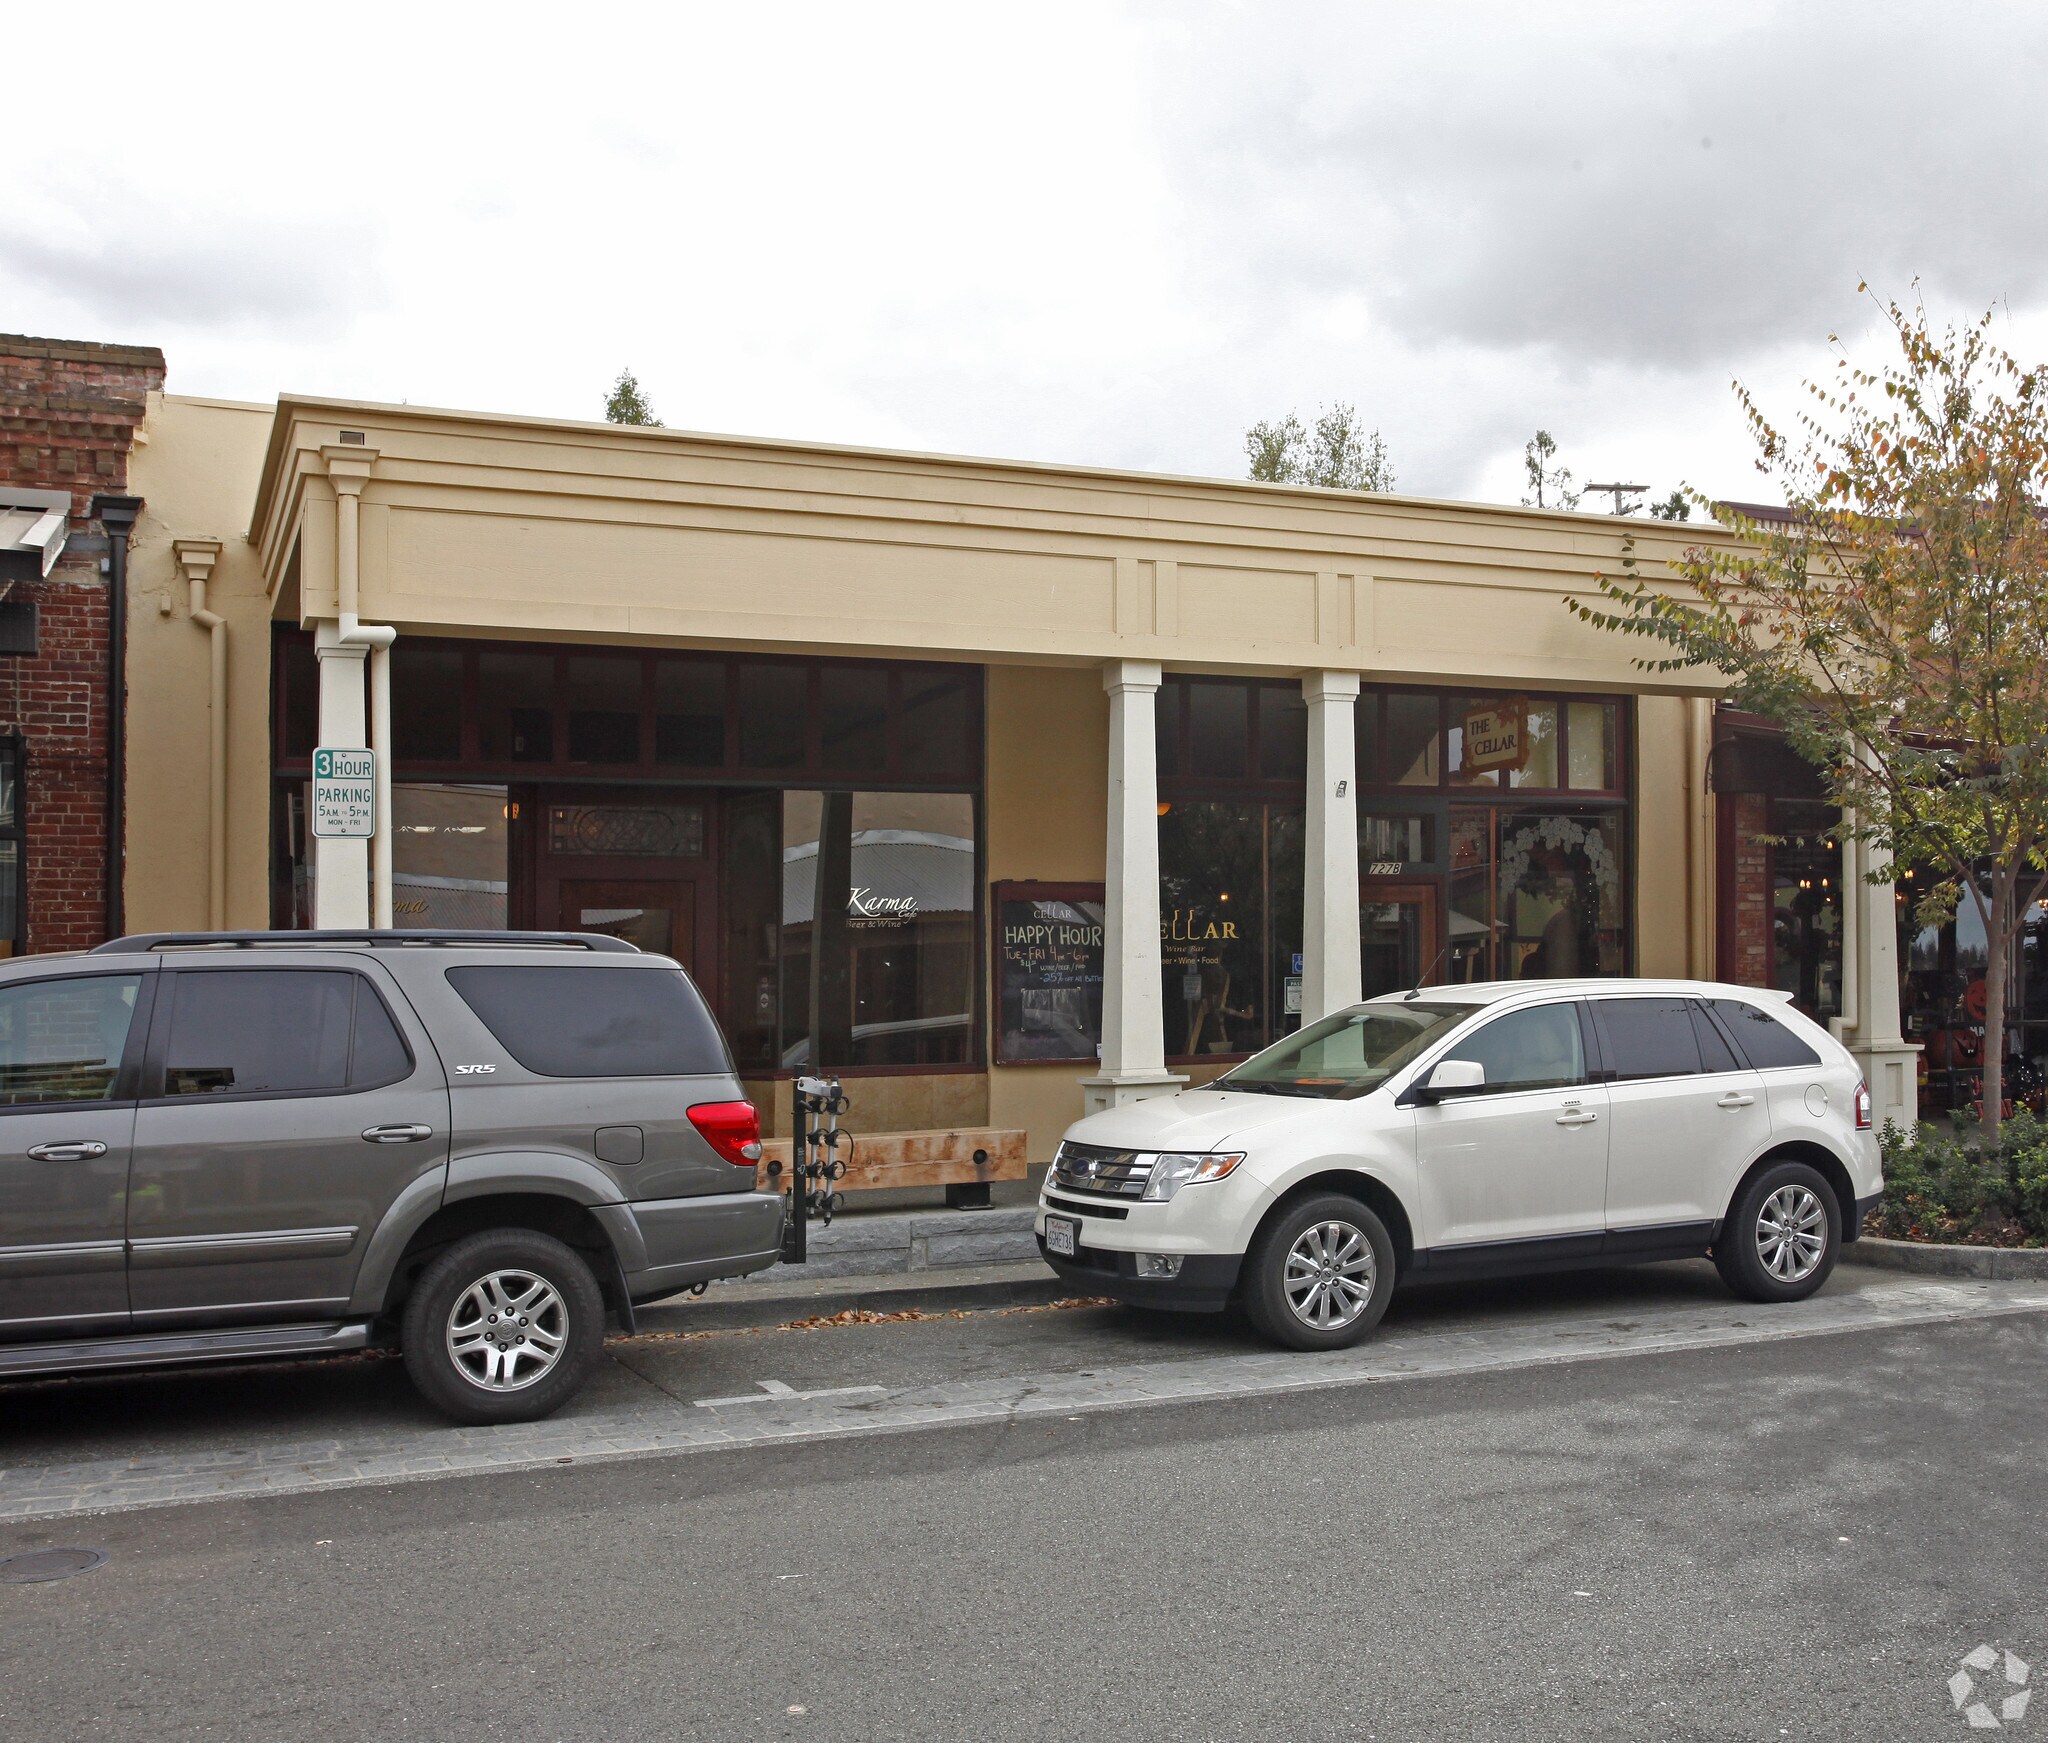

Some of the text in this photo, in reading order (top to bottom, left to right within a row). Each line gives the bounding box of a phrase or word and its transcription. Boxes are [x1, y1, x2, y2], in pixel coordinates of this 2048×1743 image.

[1470, 718, 1490, 735] THE
[1475, 735, 1517, 756] CELLAR
[318, 753, 371, 775] 3 HOUR
[318, 788, 370, 802] PARKING
[1370, 863, 1401, 874] 727B
[845, 887, 918, 918] Karma
[1033, 904, 1072, 919] CELLAR
[867, 920, 876, 928] &
[877, 919, 902, 928] Wine
[1160, 910, 1239, 940] ELLAR
[1005, 926, 1102, 946] HAPPY HOUR
[1164, 945, 1206, 953] Wine Bar
[1177, 956, 1196, 965] Wine
[1201, 956, 1219, 964] Food
[455, 1064, 496, 1075] SR5
